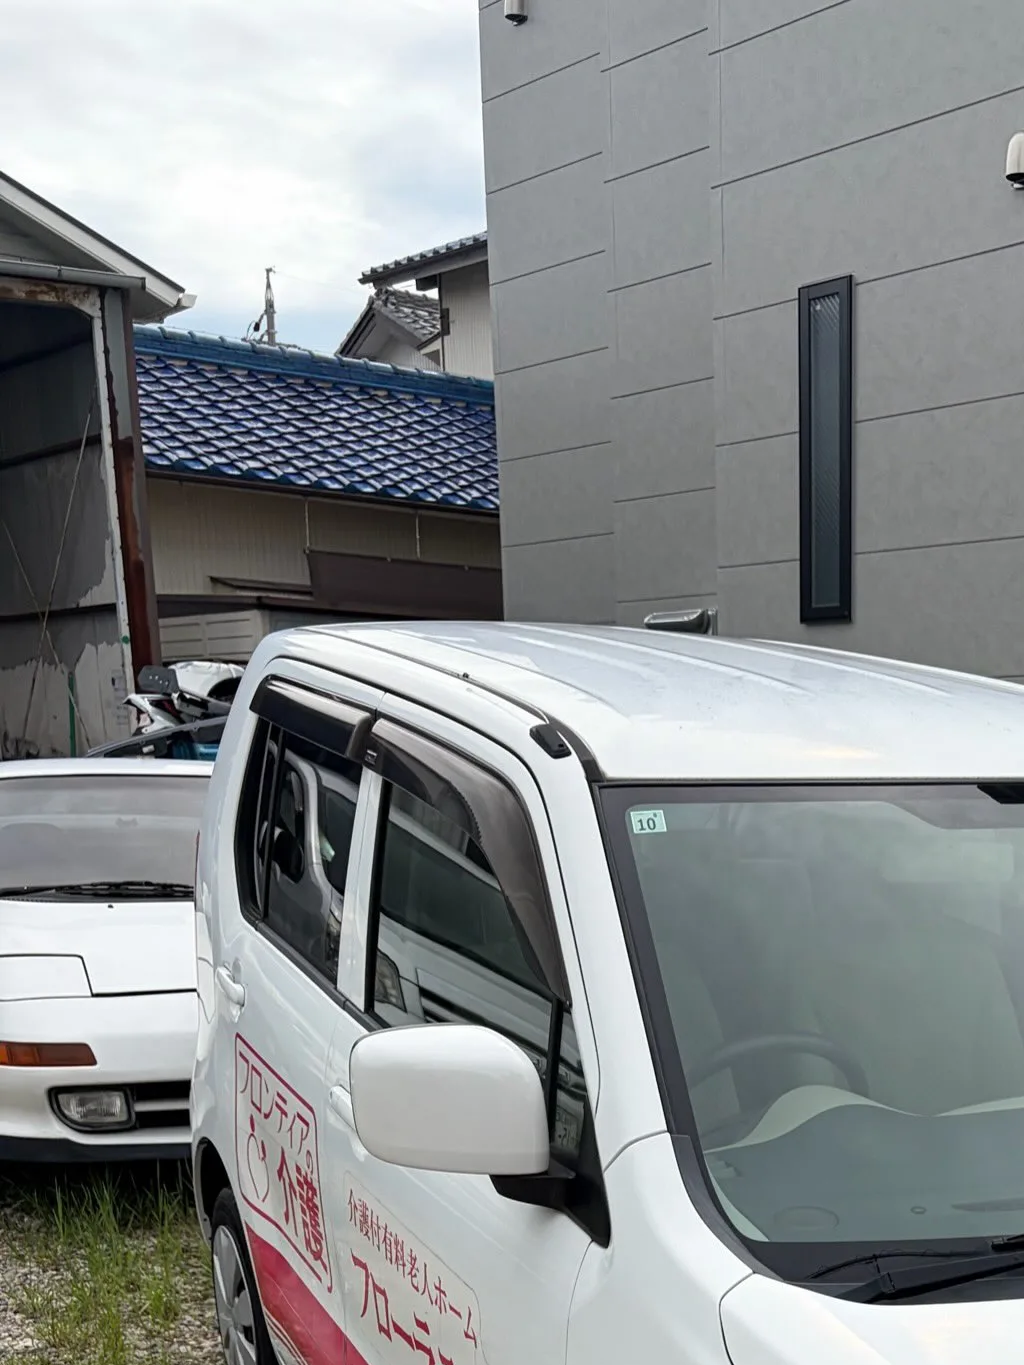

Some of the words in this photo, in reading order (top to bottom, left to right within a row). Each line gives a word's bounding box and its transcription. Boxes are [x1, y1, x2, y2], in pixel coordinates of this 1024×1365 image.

[637, 818, 657, 832] 10
[348, 1188, 478, 1349] 介護付有料老人ホーム
